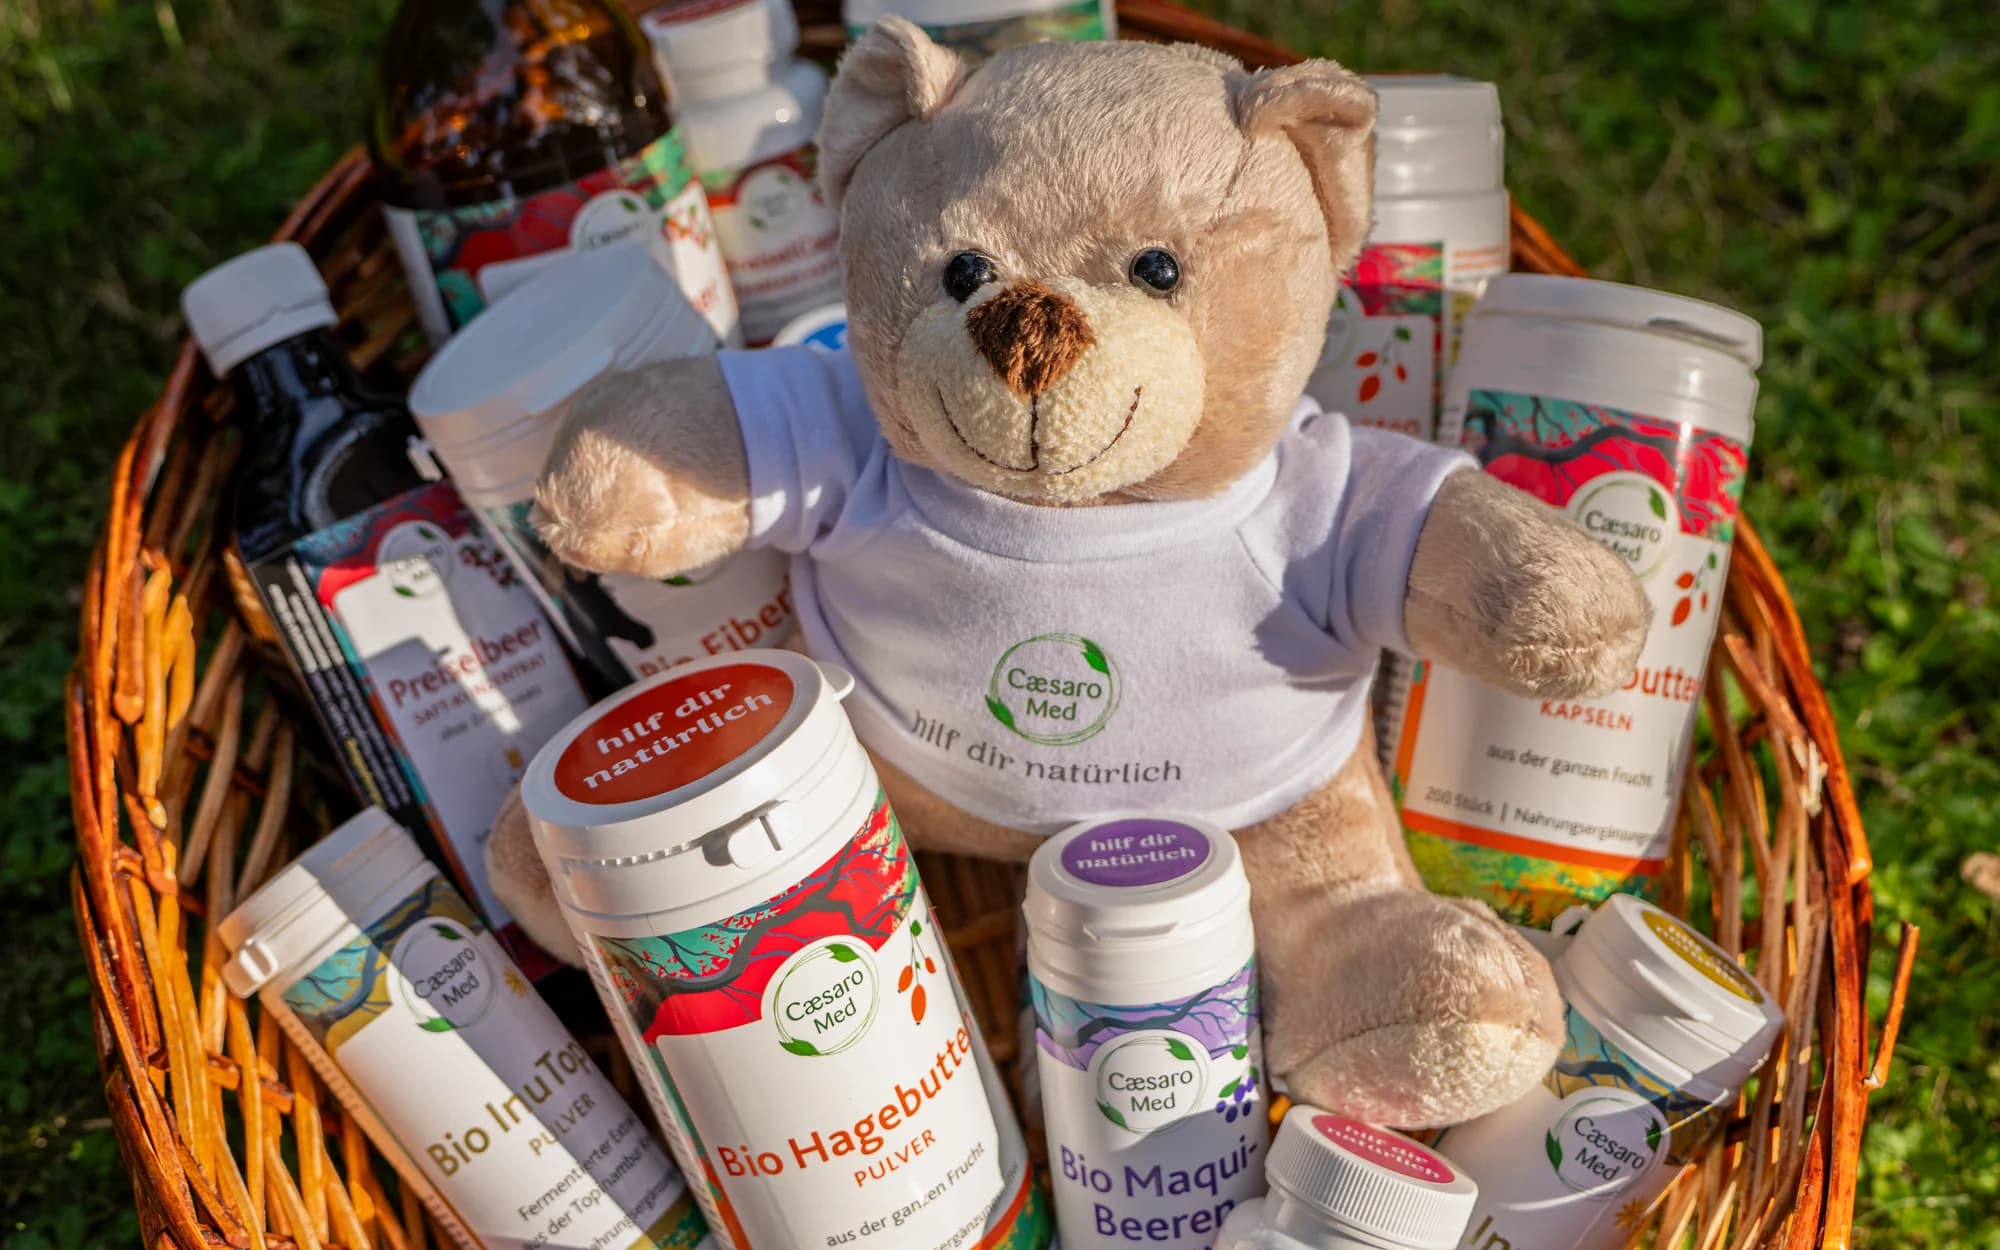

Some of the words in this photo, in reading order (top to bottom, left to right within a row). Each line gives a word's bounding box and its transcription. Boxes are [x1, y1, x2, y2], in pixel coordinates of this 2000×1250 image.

[1585, 509, 1661, 543] Cæsaro
[1007, 668, 1103, 699] Cæsaro
[596, 711, 665, 754] hilf
[674, 683, 732, 719] dir
[1025, 698, 1077, 721] Med
[1540, 700, 1634, 732] KAPSELN
[583, 692, 773, 789] natürlich
[911, 709, 961, 751] hilf
[967, 741, 1014, 771] dir
[1025, 760, 1182, 785] natürlich
[1486, 743, 1517, 762] aus
[1518, 747, 1548, 767] der
[1550, 757, 1608, 781] ganzen
[1075, 846, 1196, 869] natürlich
[1090, 836, 1135, 852] hilf
[1139, 833, 1177, 849] dir
[413, 946, 476, 999] Cæsaro
[441, 970, 481, 1008] Med
[785, 969, 864, 1022] Cæsaro
[813, 998, 857, 1034] Med
[1108, 1070, 1193, 1092] Cæsaro
[426, 1126, 491, 1178] Bio
[483, 1041, 593, 1133] InuTop
[1130, 1092, 1176, 1112] Med
[528, 1092, 596, 1156] PULVER
[1574, 1115, 1646, 1170] Cæsaro
[716, 1144, 784, 1177] Bio
[854, 1129, 937, 1188] PULVER
[1326, 1126, 1440, 1179] natürlich
[1345, 1125, 1388, 1146] hilf
[1392, 1146, 1429, 1164] dir
[517, 1139, 613, 1222] Fermentierter
[1060, 1143, 1113, 1193] Bio
[1123, 1134, 1258, 1198] Maqui-
[1574, 1146, 1621, 1182] Med
[826, 1229, 857, 1248] aus
[859, 1218, 888, 1238] der
[891, 1183, 947, 1228] ganzen
[947, 1141, 985, 1185] Frucht
[547, 1209, 575, 1235] der
